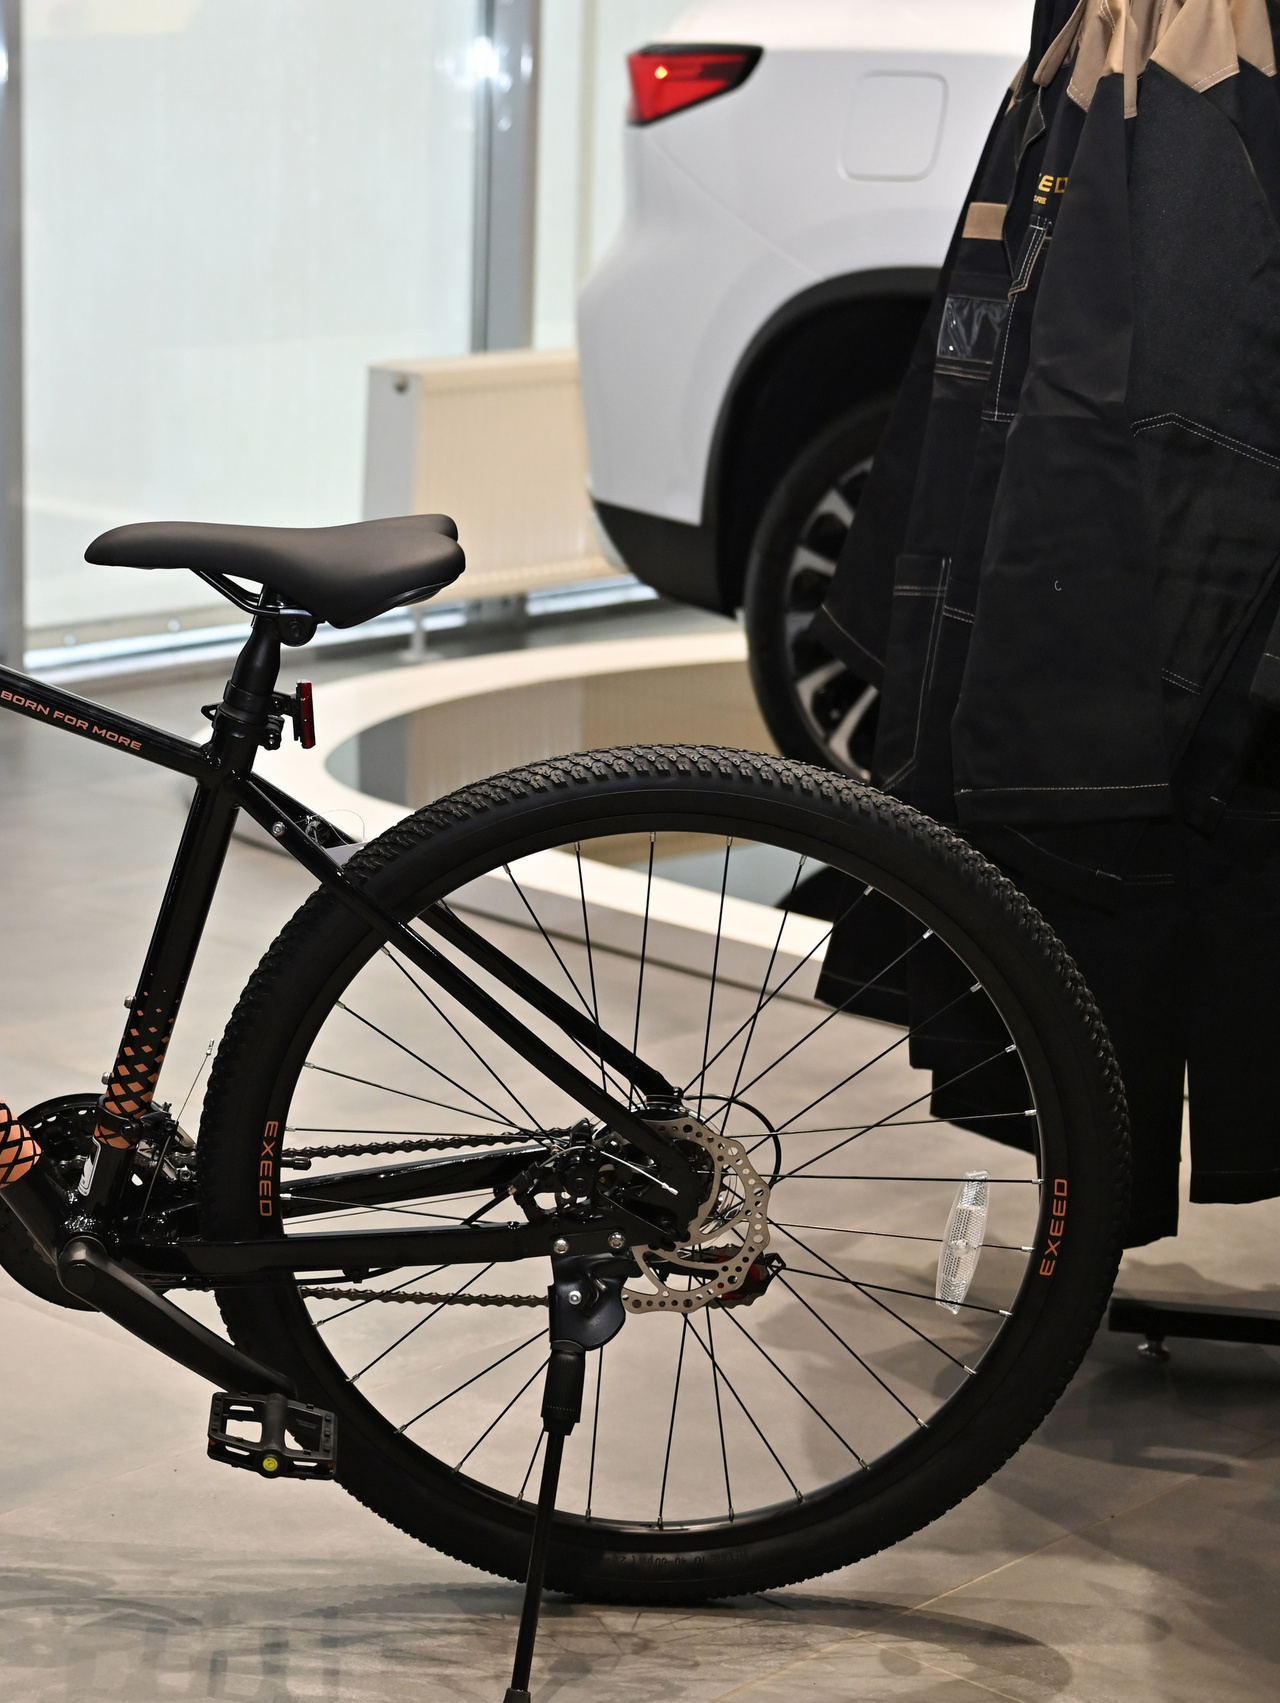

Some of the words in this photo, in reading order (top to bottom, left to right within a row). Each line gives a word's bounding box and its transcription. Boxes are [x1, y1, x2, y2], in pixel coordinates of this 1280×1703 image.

[1038, 173, 1069, 193] ED
[0, 690, 50, 715] BORN
[53, 710, 89, 730] FOR
[92, 725, 142, 750] MORE
[260, 1121, 279, 1216] EXEED
[1039, 1178, 1068, 1276] EXEED
